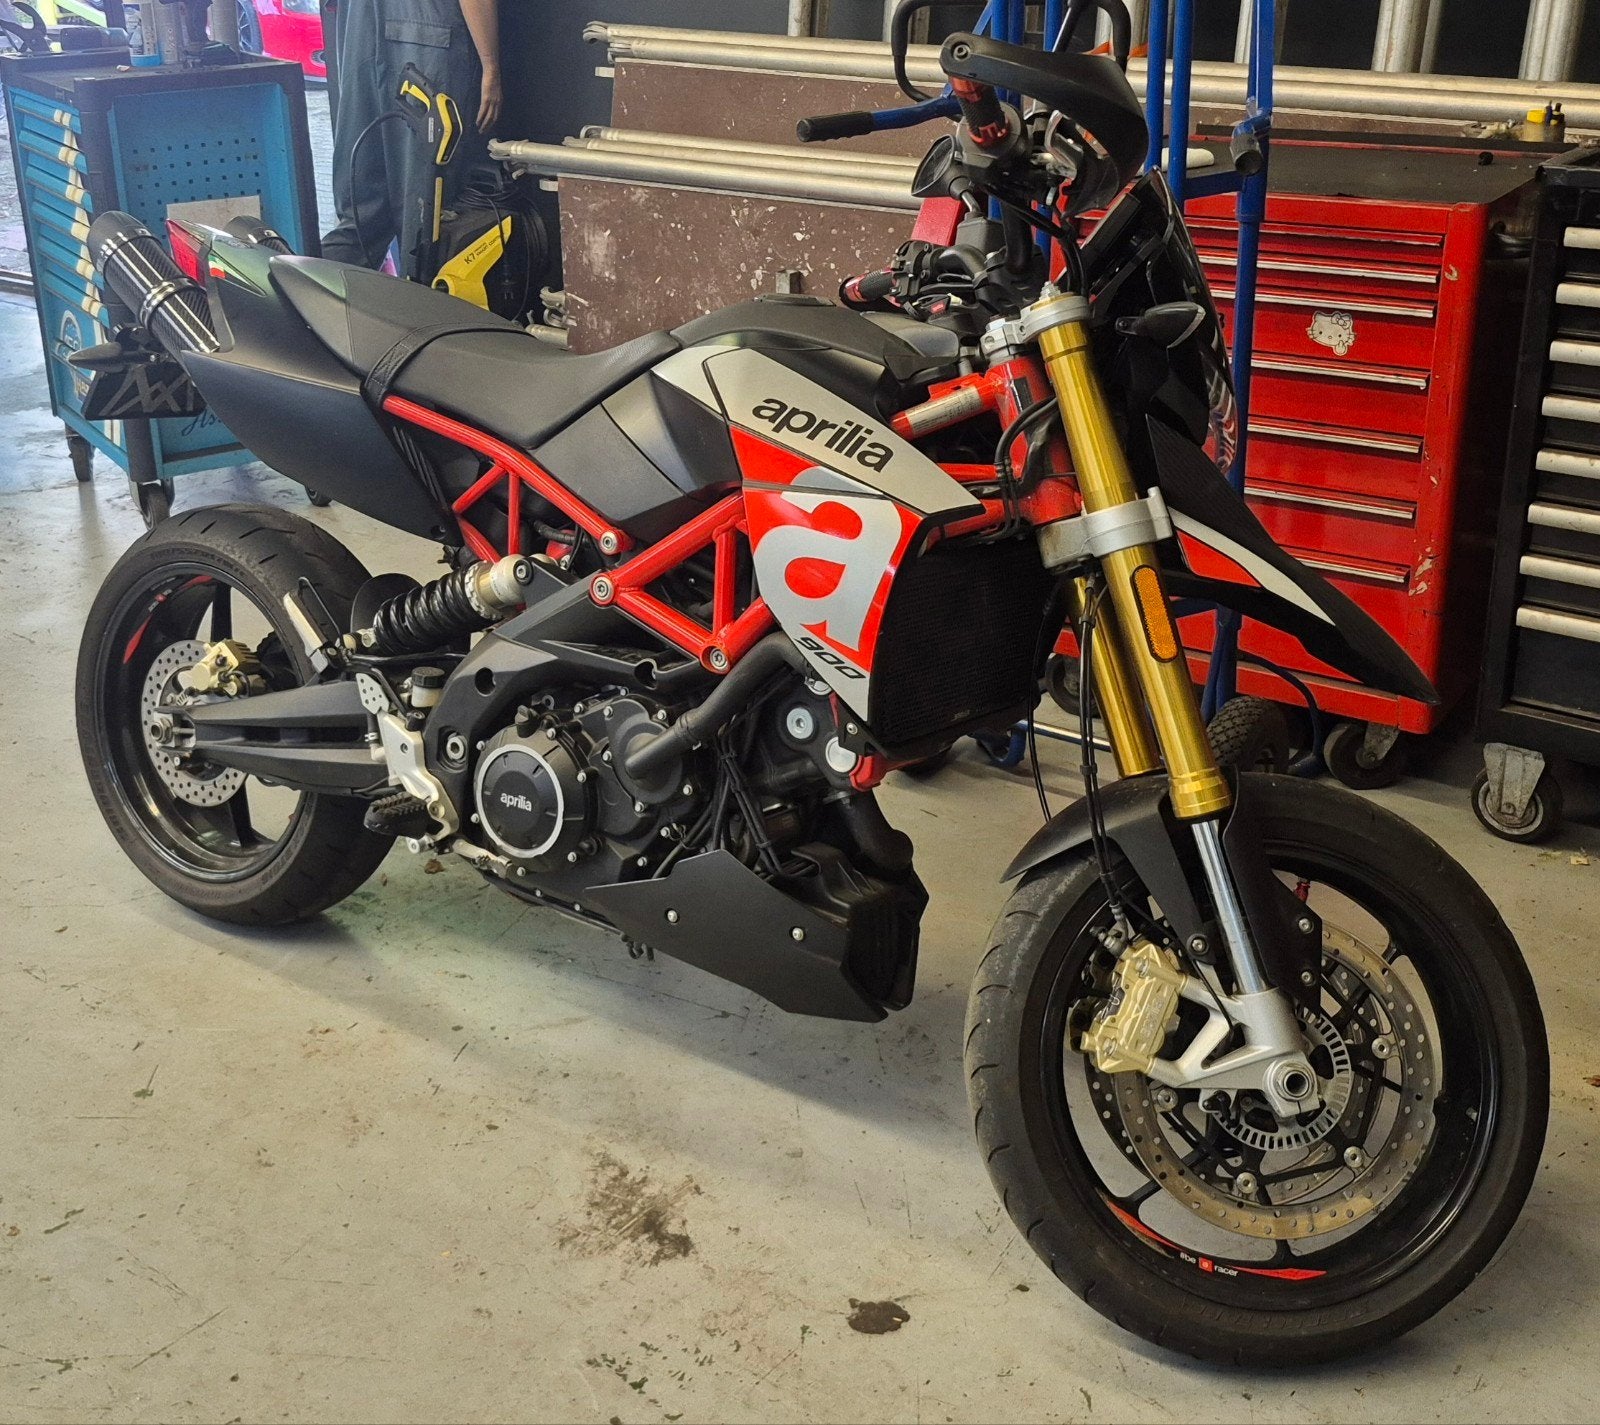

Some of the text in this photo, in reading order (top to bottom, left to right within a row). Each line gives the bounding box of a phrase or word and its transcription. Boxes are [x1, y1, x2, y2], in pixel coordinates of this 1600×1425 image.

[464, 252, 476, 264] K7
[752, 398, 894, 473] aprilia
[793, 636, 866, 680] 900
[500, 792, 532, 812] aprilia
[1214, 1265, 1239, 1277] racer
